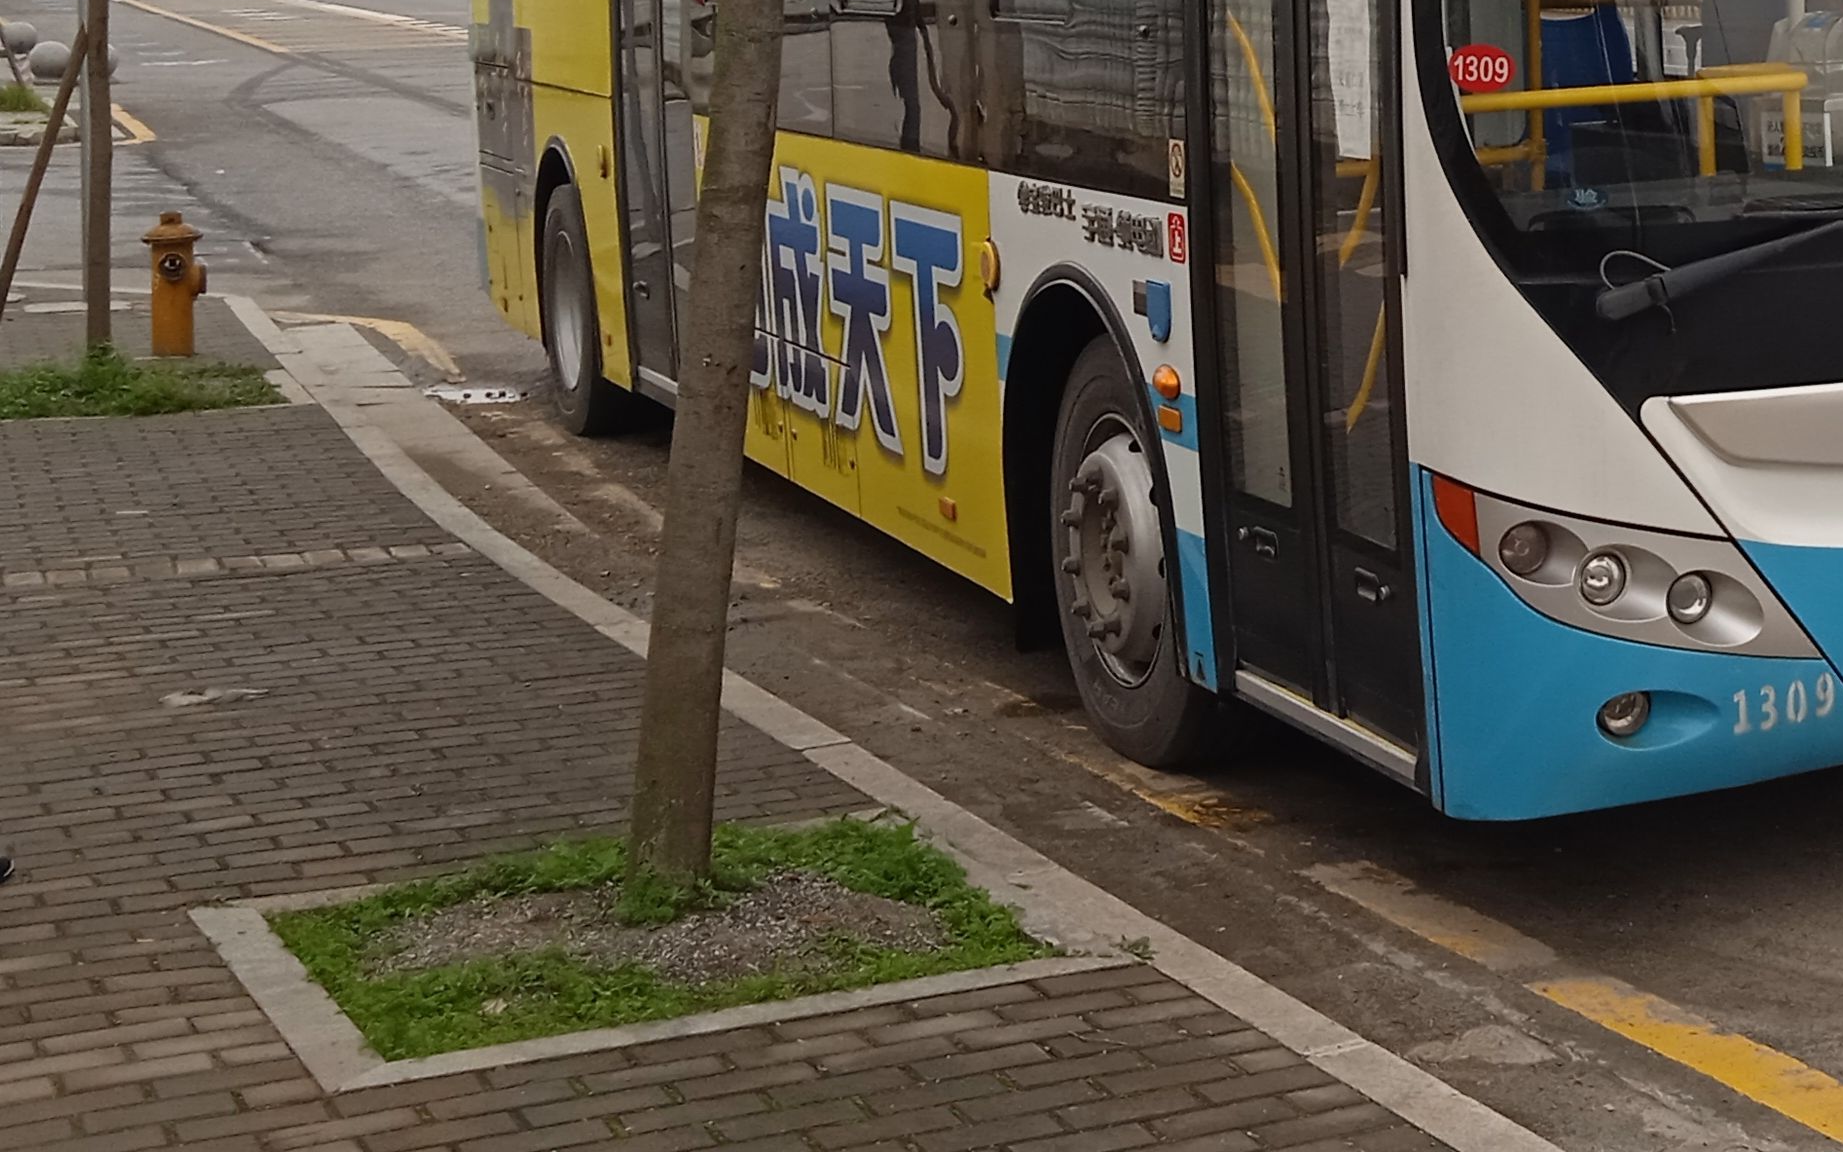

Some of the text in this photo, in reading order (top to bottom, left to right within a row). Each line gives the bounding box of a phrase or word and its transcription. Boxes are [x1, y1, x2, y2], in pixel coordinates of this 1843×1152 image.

[1453, 54, 1509, 83] 1309
[750, 166, 964, 476] 成天下
[1733, 671, 1836, 735] 1309
